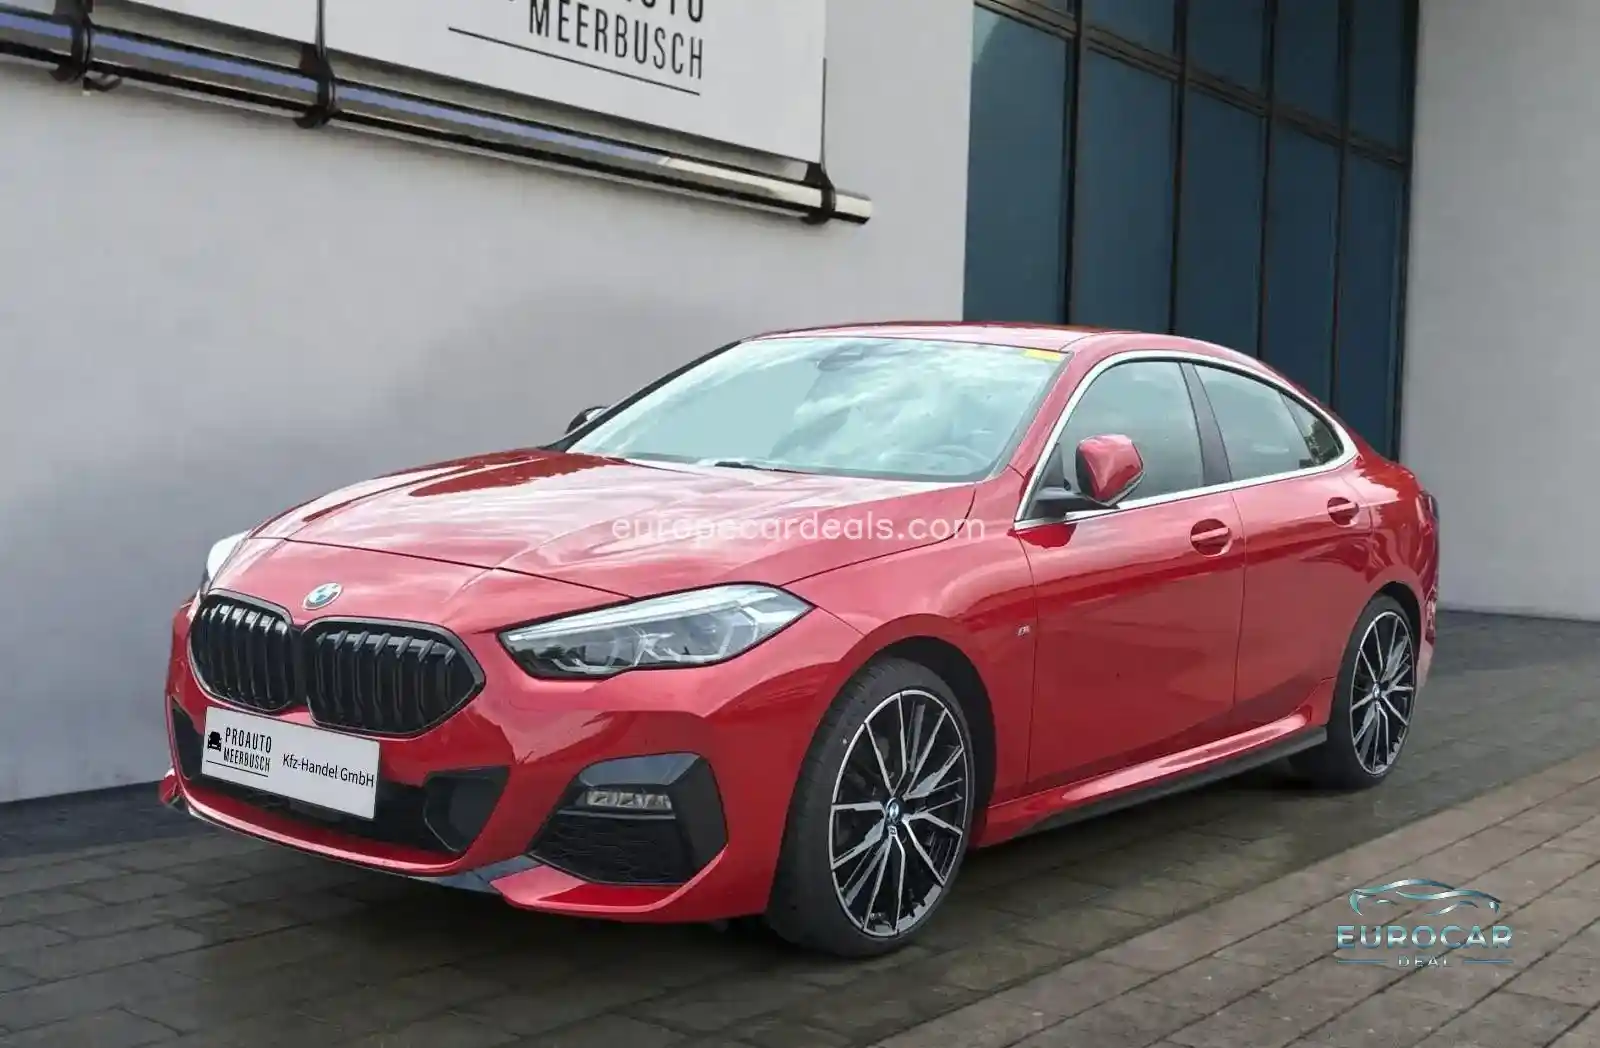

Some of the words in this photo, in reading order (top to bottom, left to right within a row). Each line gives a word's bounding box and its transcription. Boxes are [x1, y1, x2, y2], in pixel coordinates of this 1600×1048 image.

[529, 0, 703, 79] MEERBUSCH
[224, 727, 272, 753] PROAUTO
[223, 748, 271, 772] MEERBUSCH
[282, 753, 338, 778] Kfz-Handel
[340, 767, 375, 788] GmbH
